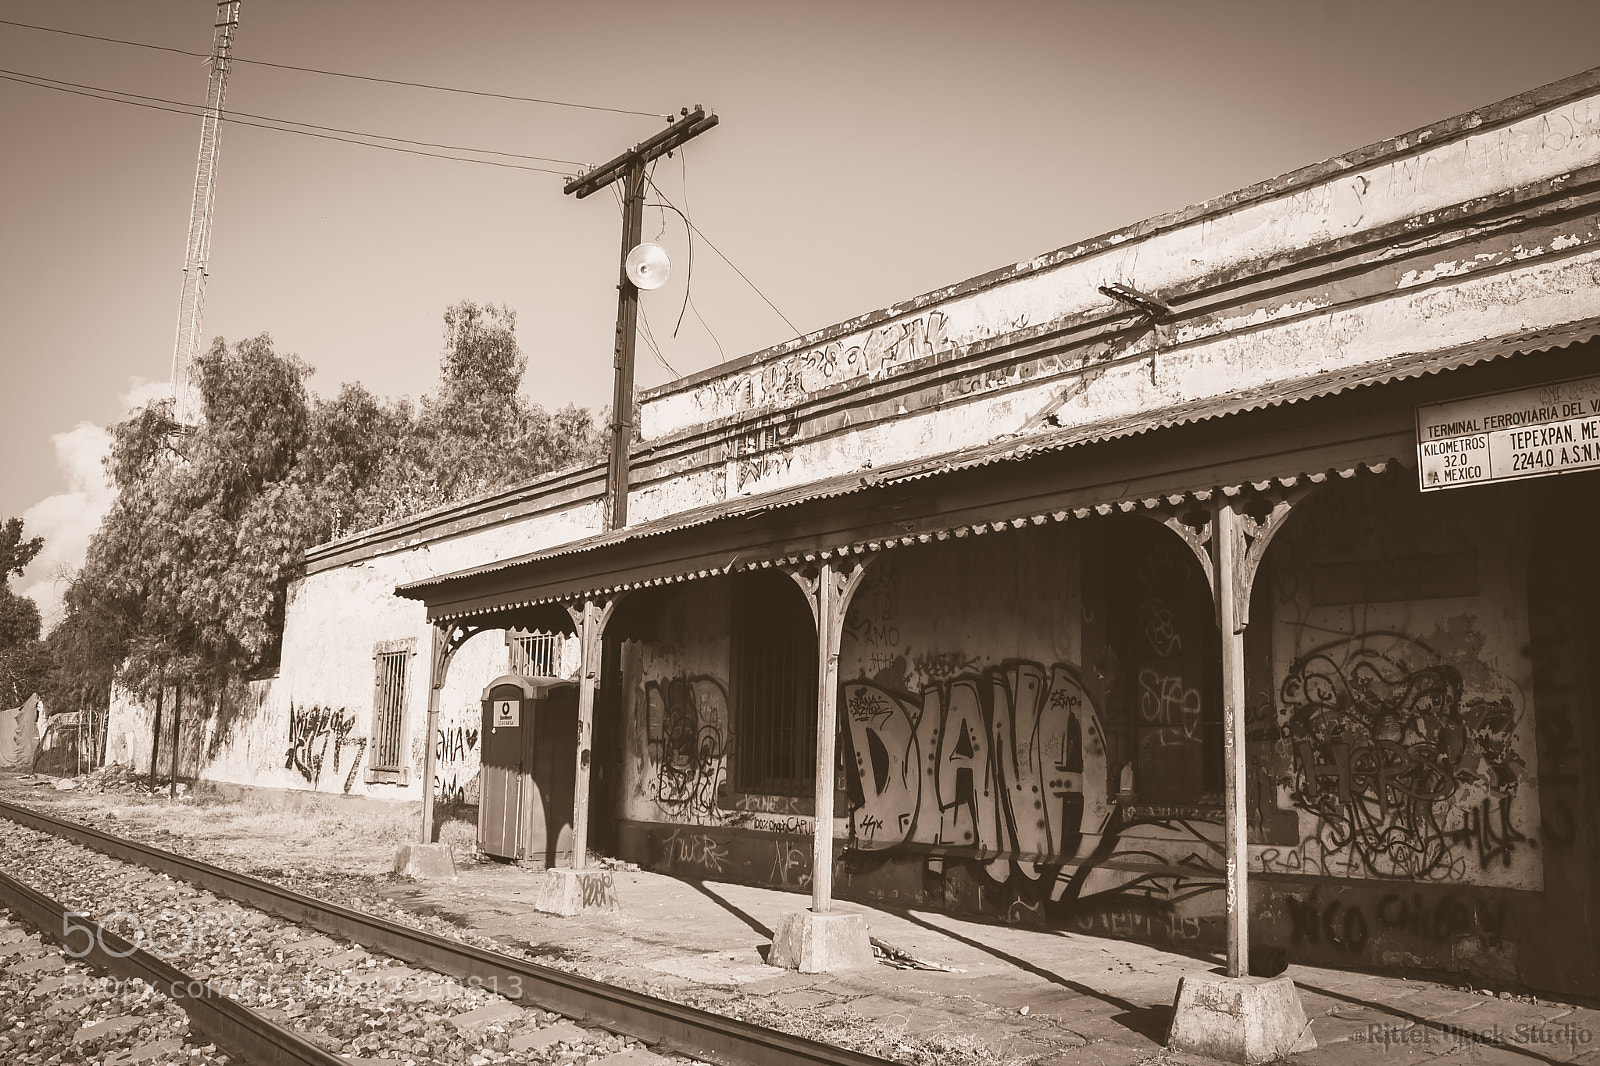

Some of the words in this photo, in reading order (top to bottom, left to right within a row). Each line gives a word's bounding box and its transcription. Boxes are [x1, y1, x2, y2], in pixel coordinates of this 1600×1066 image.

[1427, 418, 1481, 438] TERMINAL
[1483, 407, 1559, 430] FERROVIARIA
[1562, 401, 1586, 417] DEL
[1581, 421, 1600, 440] ME
[1424, 436, 1486, 457] KILOMETROS
[1443, 453, 1468, 468] 32.0
[1432, 471, 1440, 484] A
[1444, 465, 1482, 481] MEXICO
